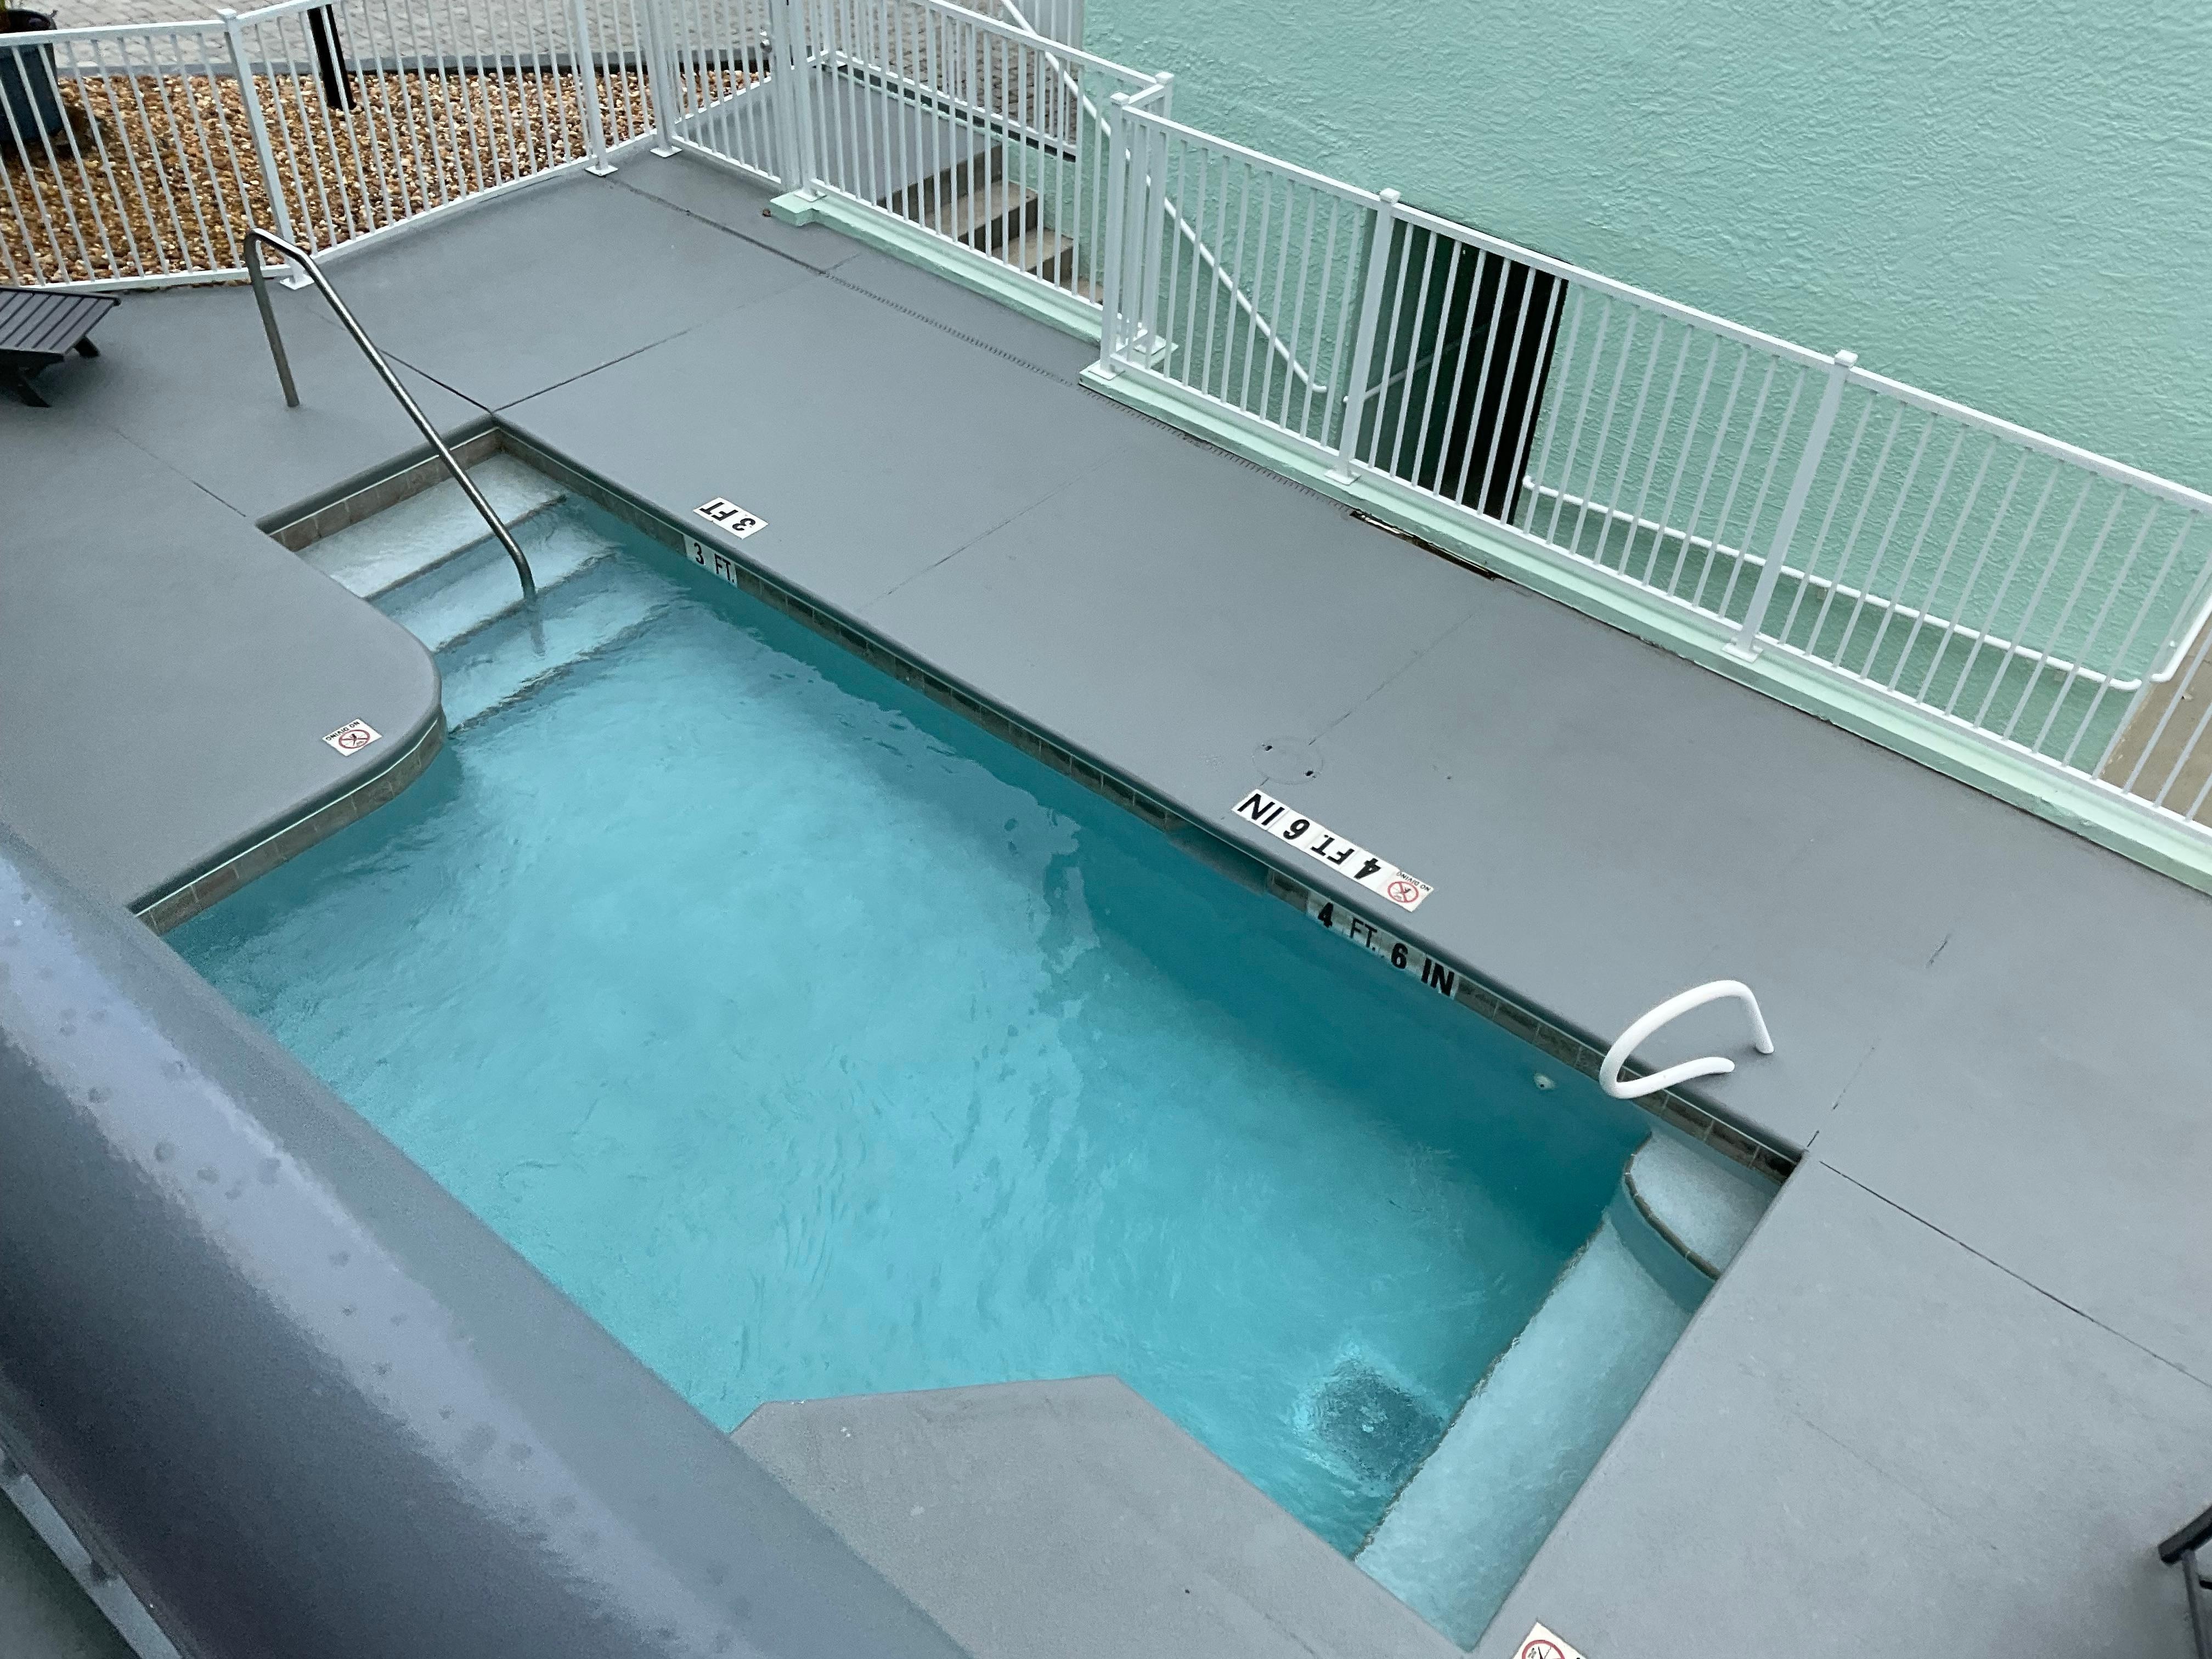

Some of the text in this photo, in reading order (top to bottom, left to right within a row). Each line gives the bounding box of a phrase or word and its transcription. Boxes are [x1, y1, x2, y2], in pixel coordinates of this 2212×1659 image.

[698, 501, 756, 531] 3 FT
[694, 543, 704, 565] 3
[325, 727, 349, 741] DIVING
[1237, 793, 1381, 880] 4 FT. 6 IN
[1396, 871, 1420, 886] DIVING
[1317, 902, 1334, 929] 4
[1391, 943, 1408, 970] 6
[1420, 957, 1455, 997] IN
